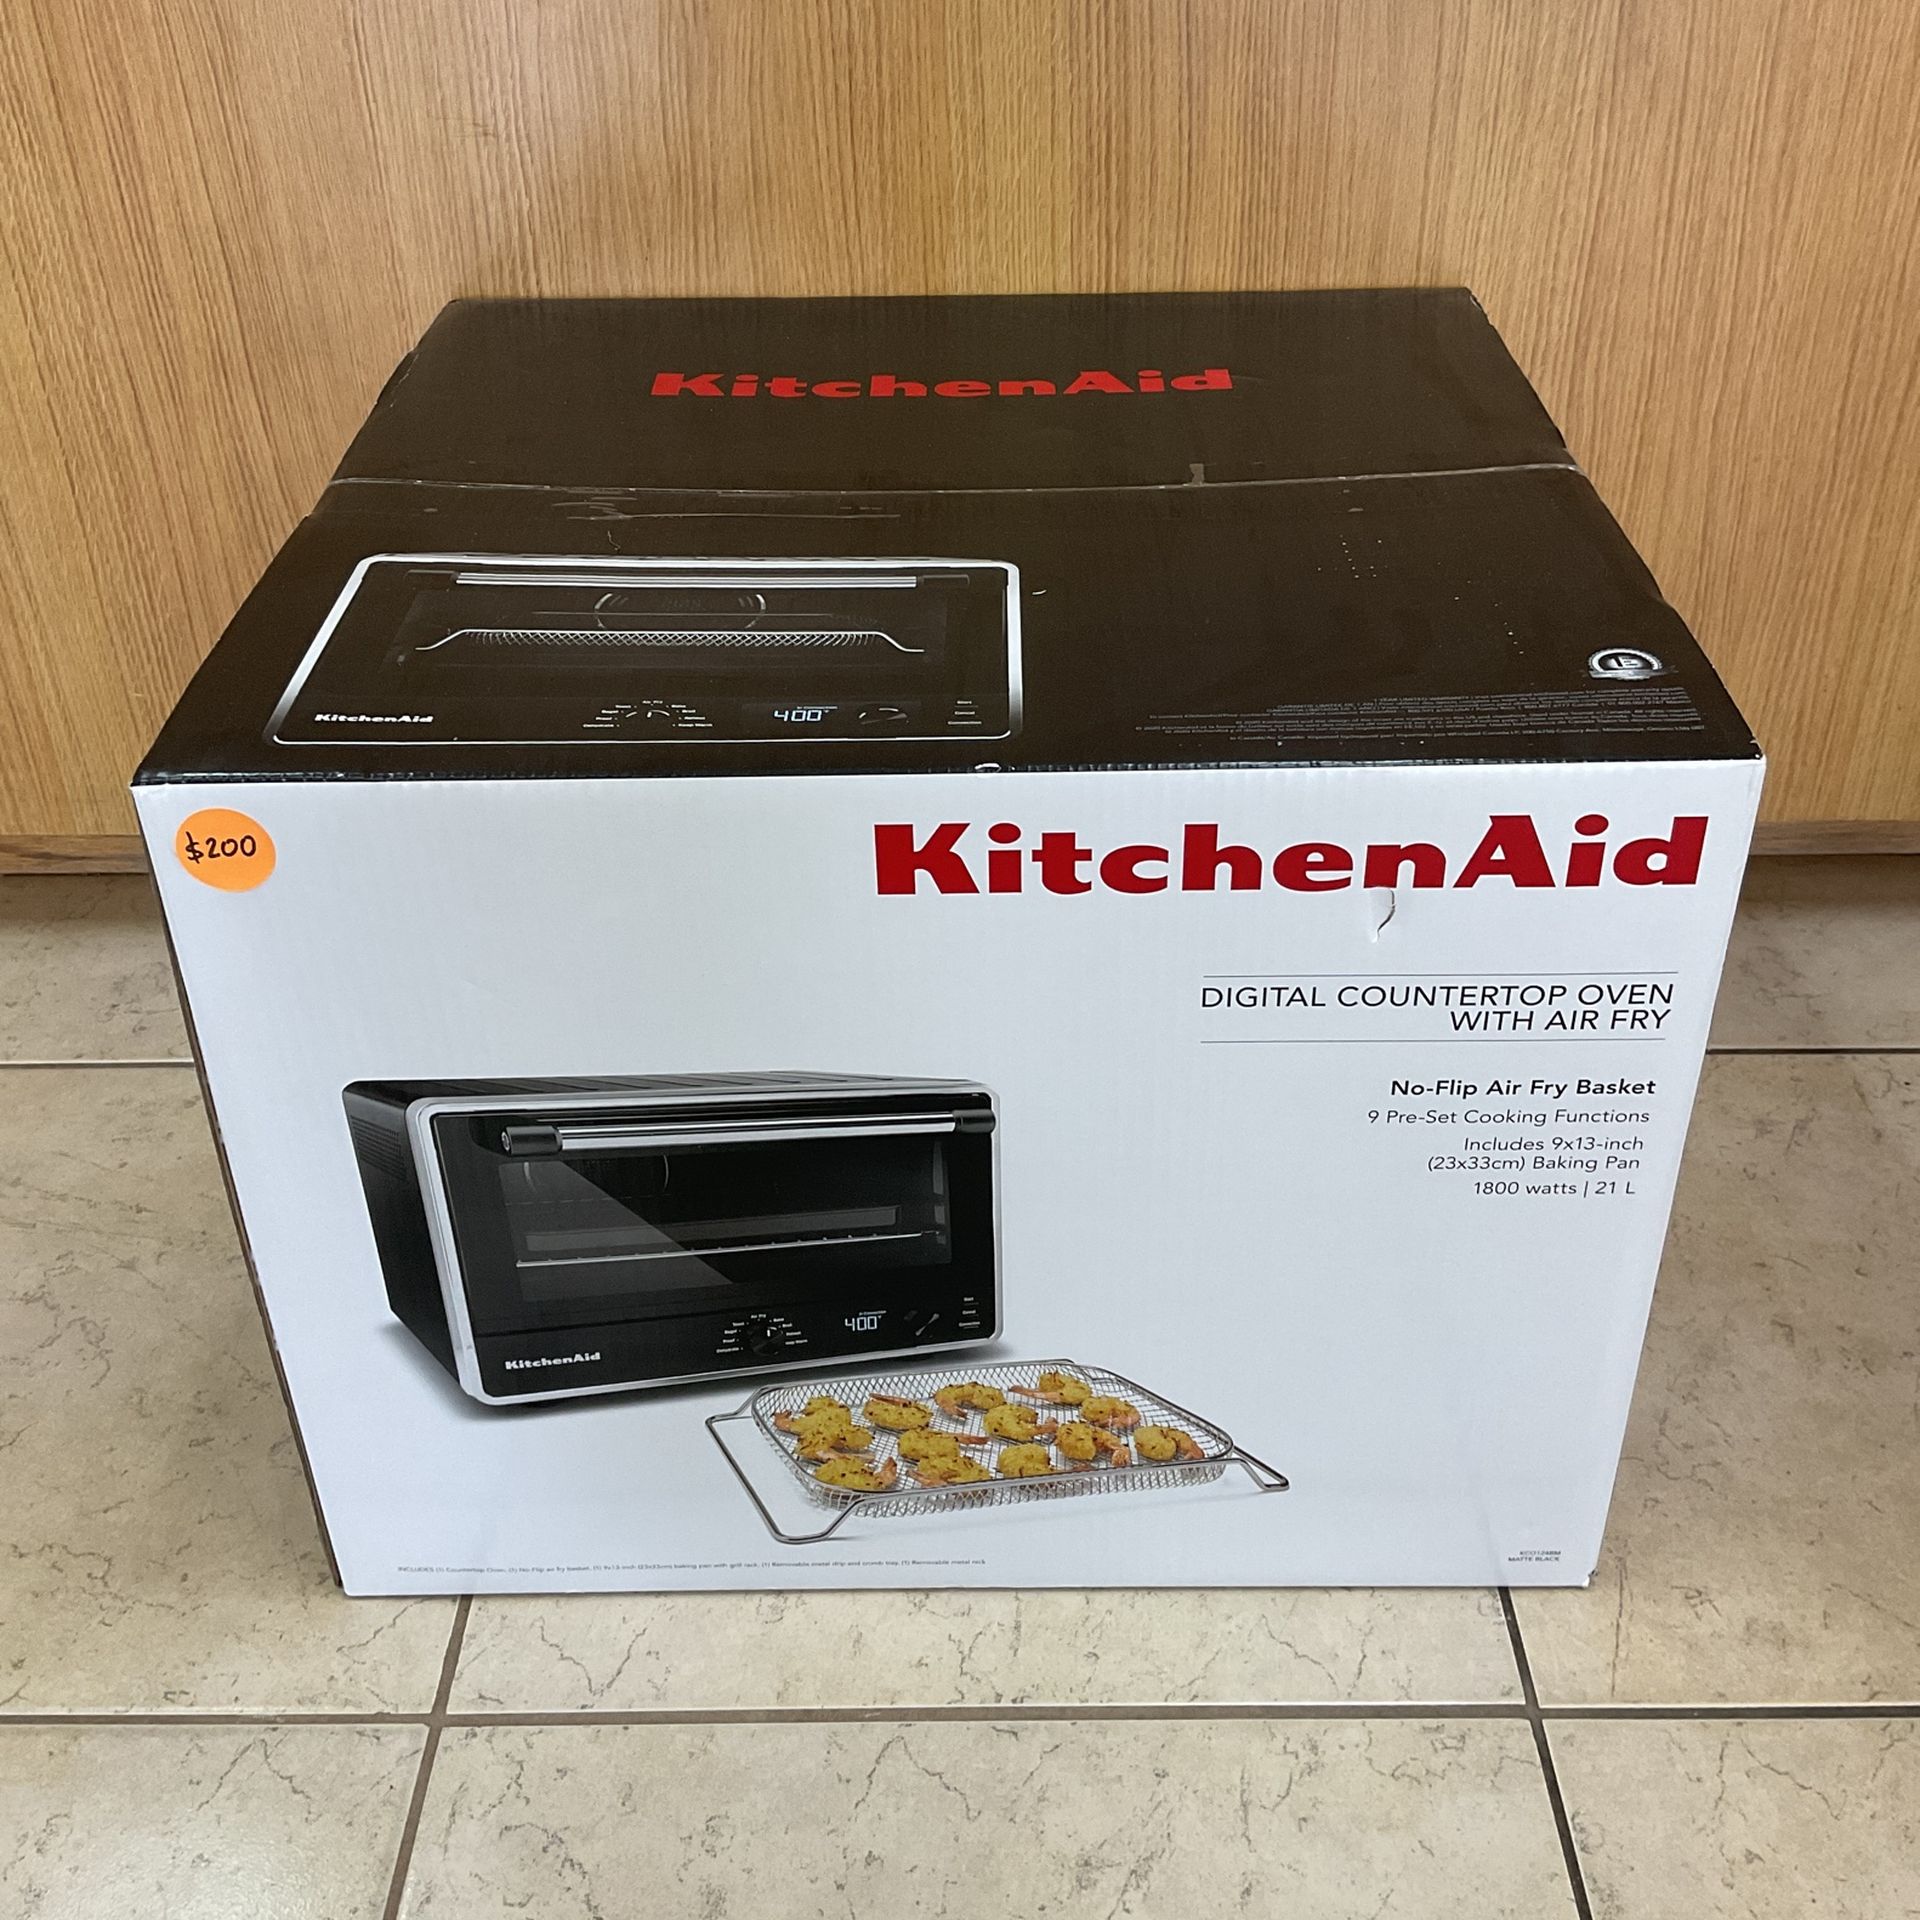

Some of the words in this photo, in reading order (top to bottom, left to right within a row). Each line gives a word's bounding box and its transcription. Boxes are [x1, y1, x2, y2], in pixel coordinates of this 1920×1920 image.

[650, 368, 1233, 398] KitchenAid
[314, 713, 434, 723] KitchenAid
[184, 830, 257, 865] $200
[874, 814, 1709, 896] KitchenAid
[1201, 985, 1327, 1009] DIGITAL
[1336, 983, 1567, 1008] COUNTERTOP
[1577, 983, 1674, 1006] OVEN
[1450, 1010, 1534, 1032] WITH
[1544, 1009, 1598, 1031] AIR
[1610, 1008, 1671, 1030] FRY
[1390, 1079, 1478, 1100] No-Flip
[1486, 1079, 1522, 1096] Air
[1530, 1079, 1568, 1099] Fry
[1576, 1078, 1656, 1095] Basket
[1367, 1109, 1379, 1124] 9
[1386, 1109, 1457, 1124] Pre-Set
[1464, 1109, 1547, 1127] Cooking
[1554, 1108, 1650, 1123] Functions
[1464, 1137, 1545, 1151] Includes
[1551, 1136, 1644, 1151] 9x13-inch
[1427, 1156, 1526, 1172] (23x33cm)
[1532, 1155, 1598, 1172] Baking
[1605, 1155, 1640, 1169] Pan
[1473, 1181, 1520, 1195] 1800
[1525, 1181, 1578, 1195] watts
[1594, 1180, 1617, 1194] 21
[1625, 1180, 1636, 1194] L
[504, 1351, 601, 1370] KitchenAid
